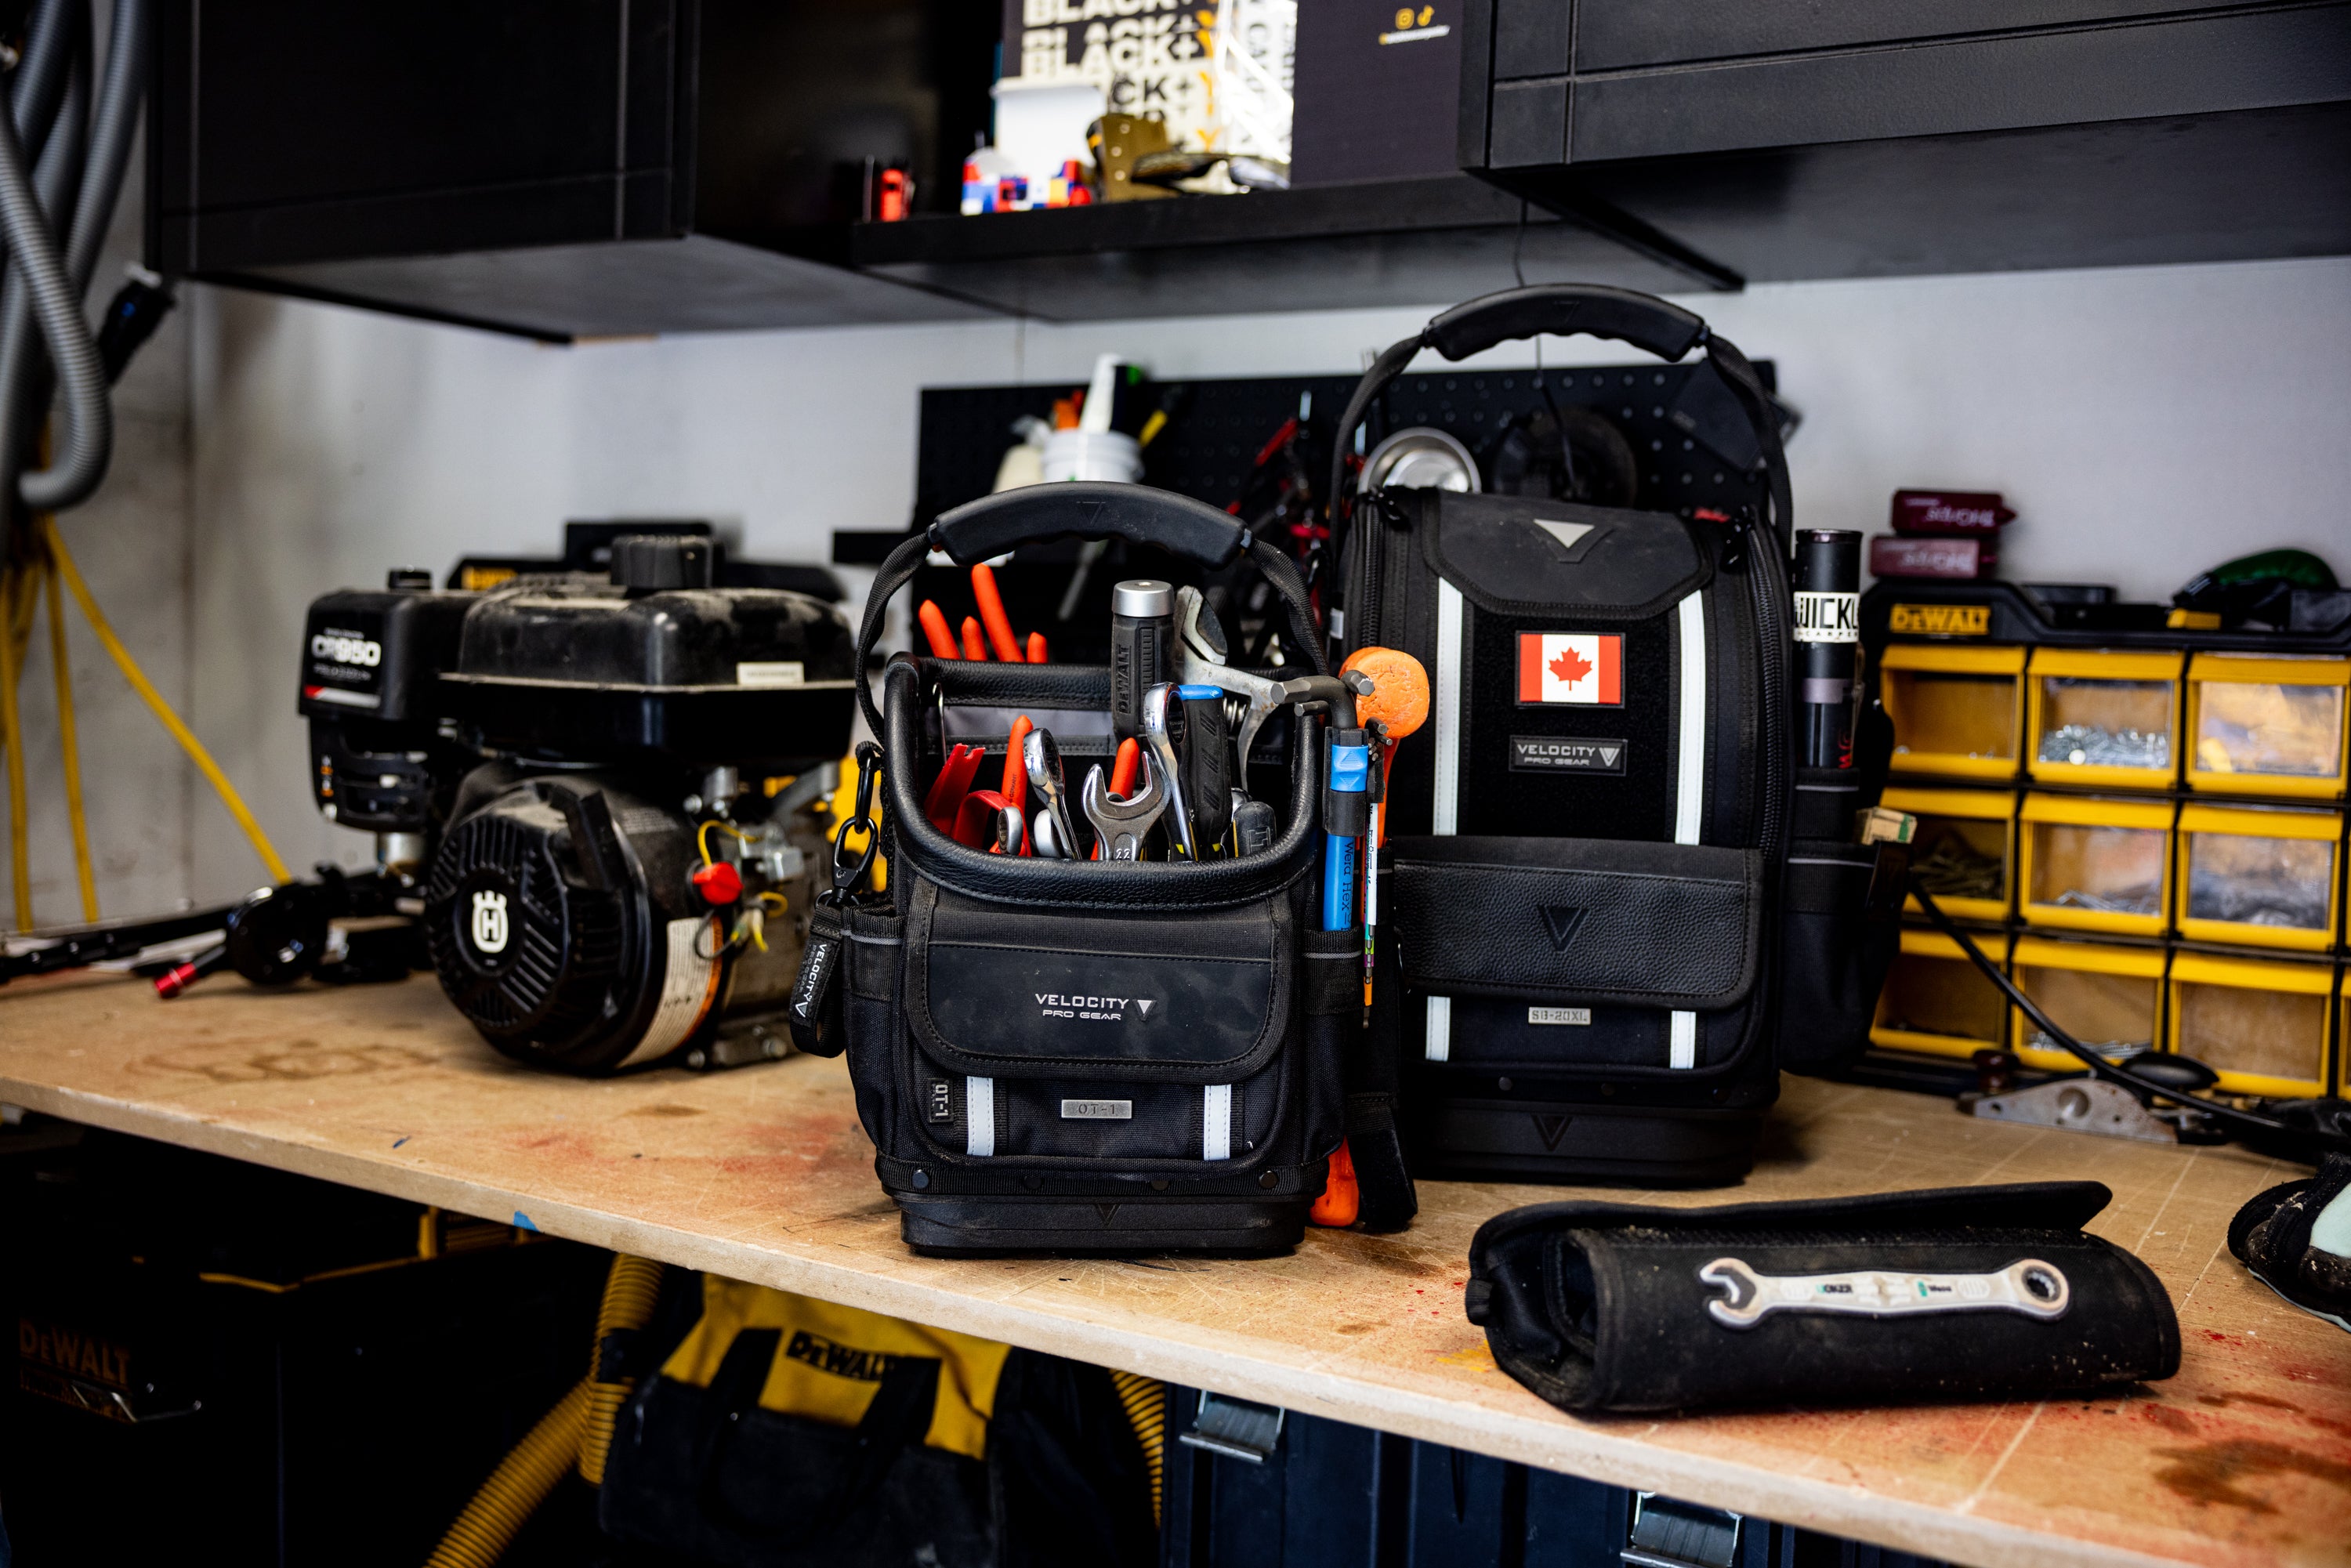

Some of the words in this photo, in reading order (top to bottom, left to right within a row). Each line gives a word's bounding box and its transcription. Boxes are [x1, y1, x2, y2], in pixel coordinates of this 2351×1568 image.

[1517, 744, 1596, 757] VELOCITY
[1524, 756, 1552, 765] PRO
[1116, 848, 1131, 860] 22
[1344, 841, 1355, 876] Wera
[1342, 882, 1353, 911] Hex
[803, 943, 827, 1002] VELOCITY
[1034, 993, 1129, 1009] VELOCITY
[1042, 1009, 1074, 1018] PRO
[1079, 1012, 1121, 1020] GEAR
[1531, 1009, 1588, 1022] SB-20XL
[935, 1084, 949, 1117] OT-1
[1078, 1103, 1116, 1115] OT-1
